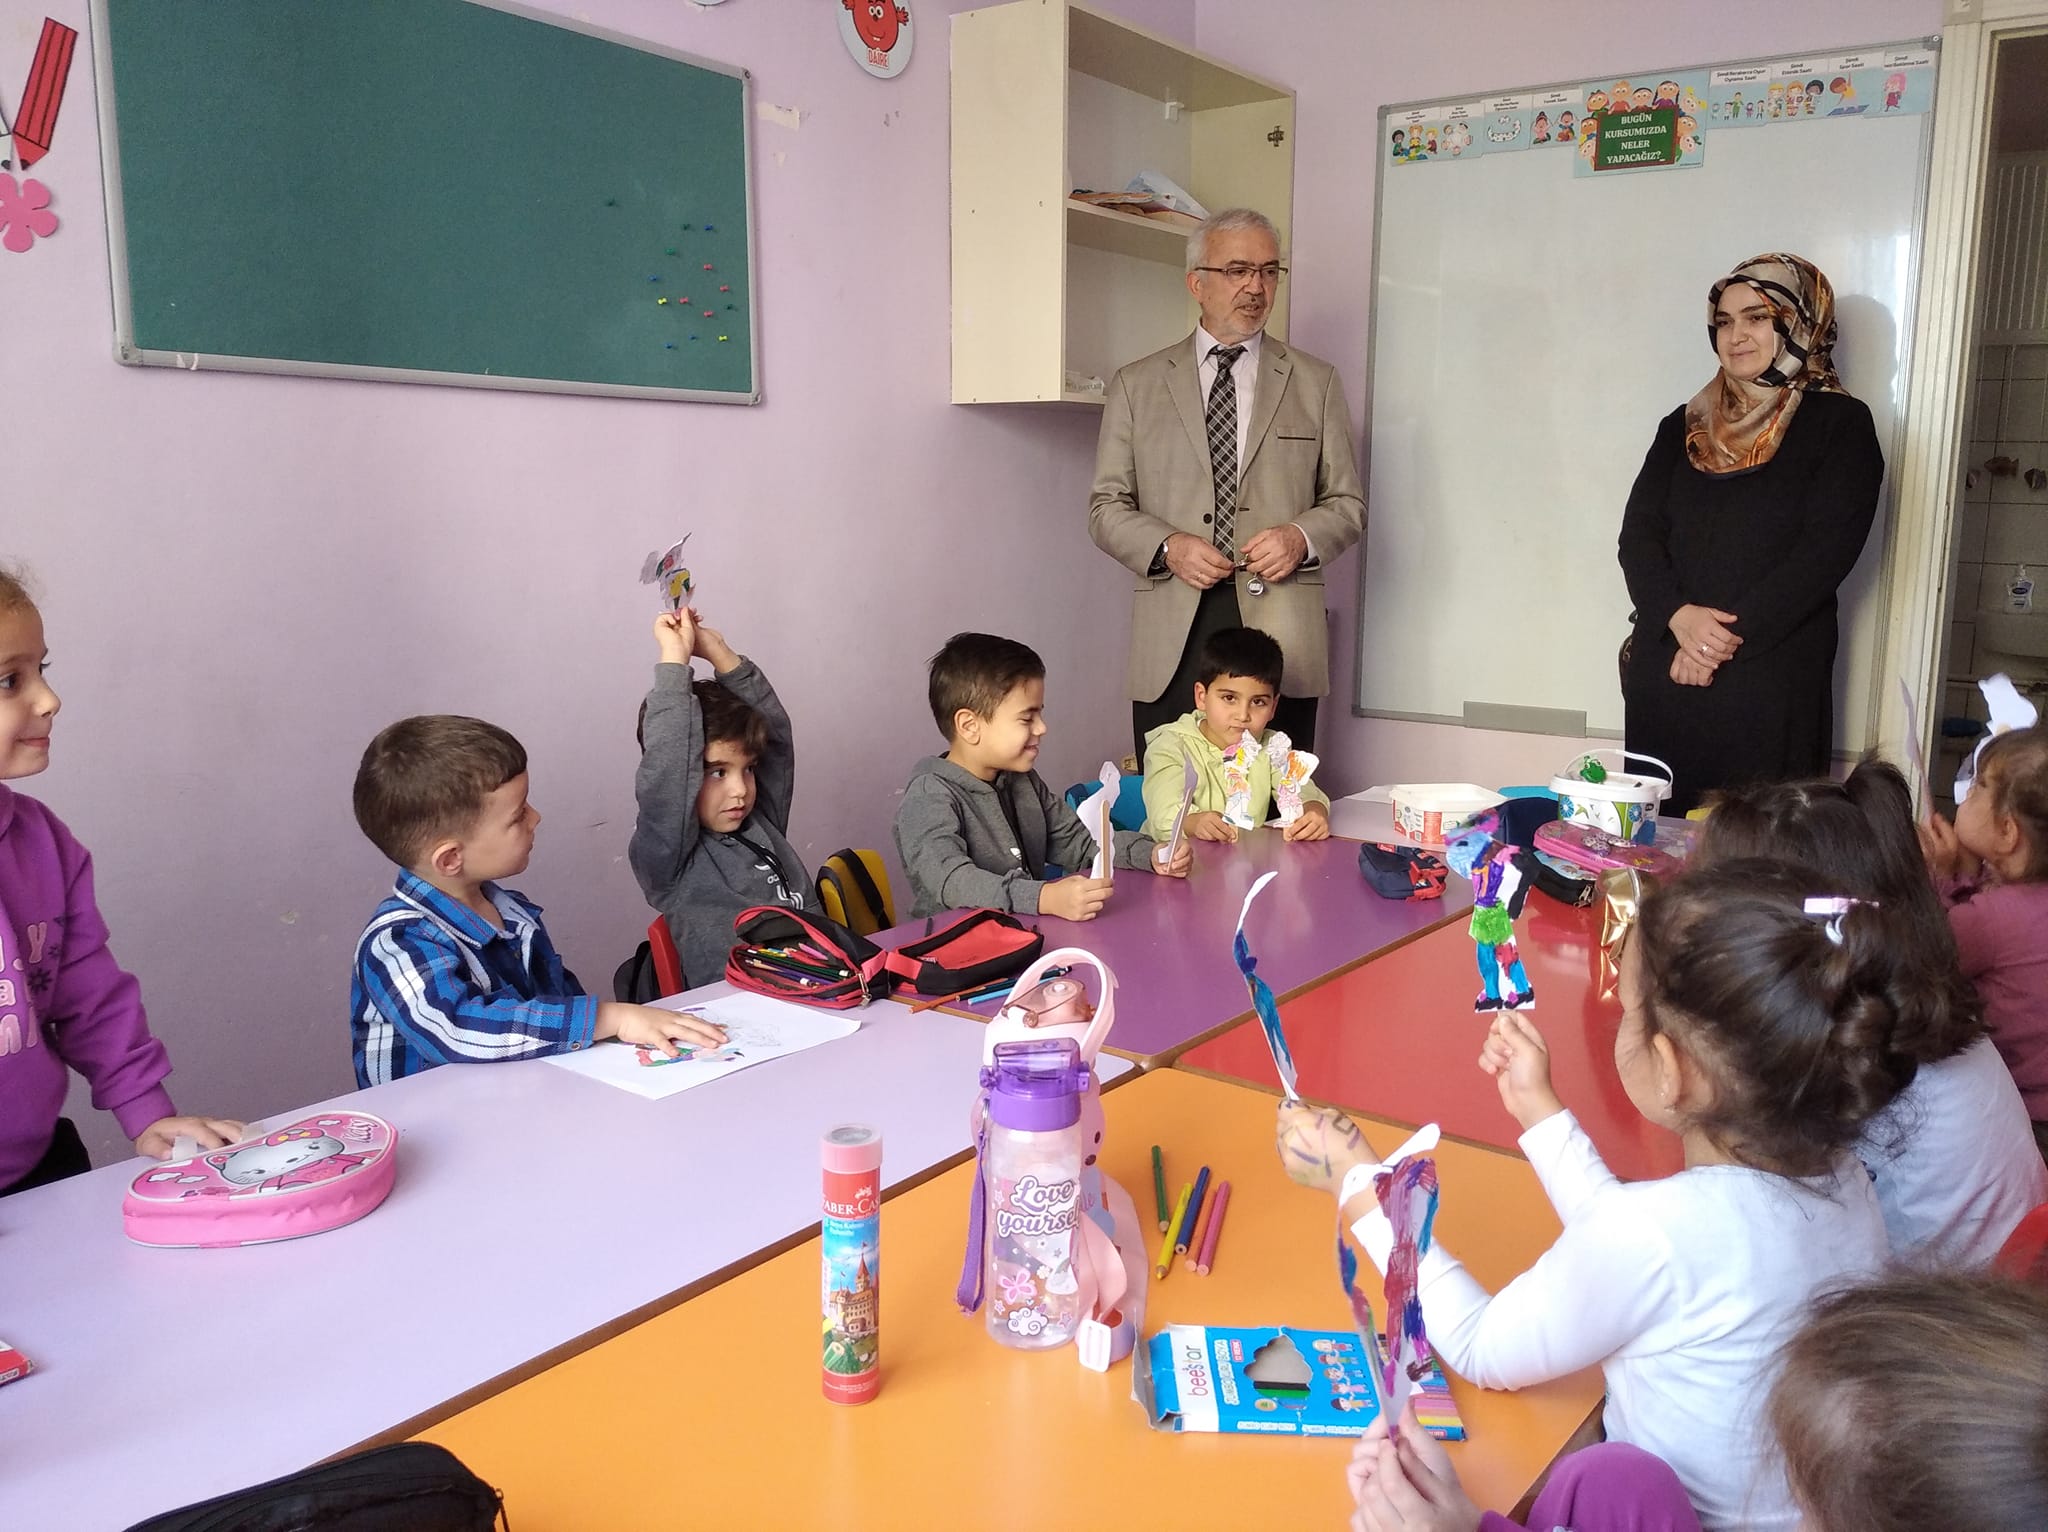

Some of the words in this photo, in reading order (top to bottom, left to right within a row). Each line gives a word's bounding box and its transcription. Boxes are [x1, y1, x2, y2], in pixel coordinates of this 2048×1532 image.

[1621, 113, 1652, 125] BUGÜN
[1605, 126, 1667, 139] KURSUMUZDA
[1621, 140, 1650, 150] NELER
[1606, 151, 1661, 164] YAPACAĞIZ?
[1012, 1177, 1073, 1213] Love
